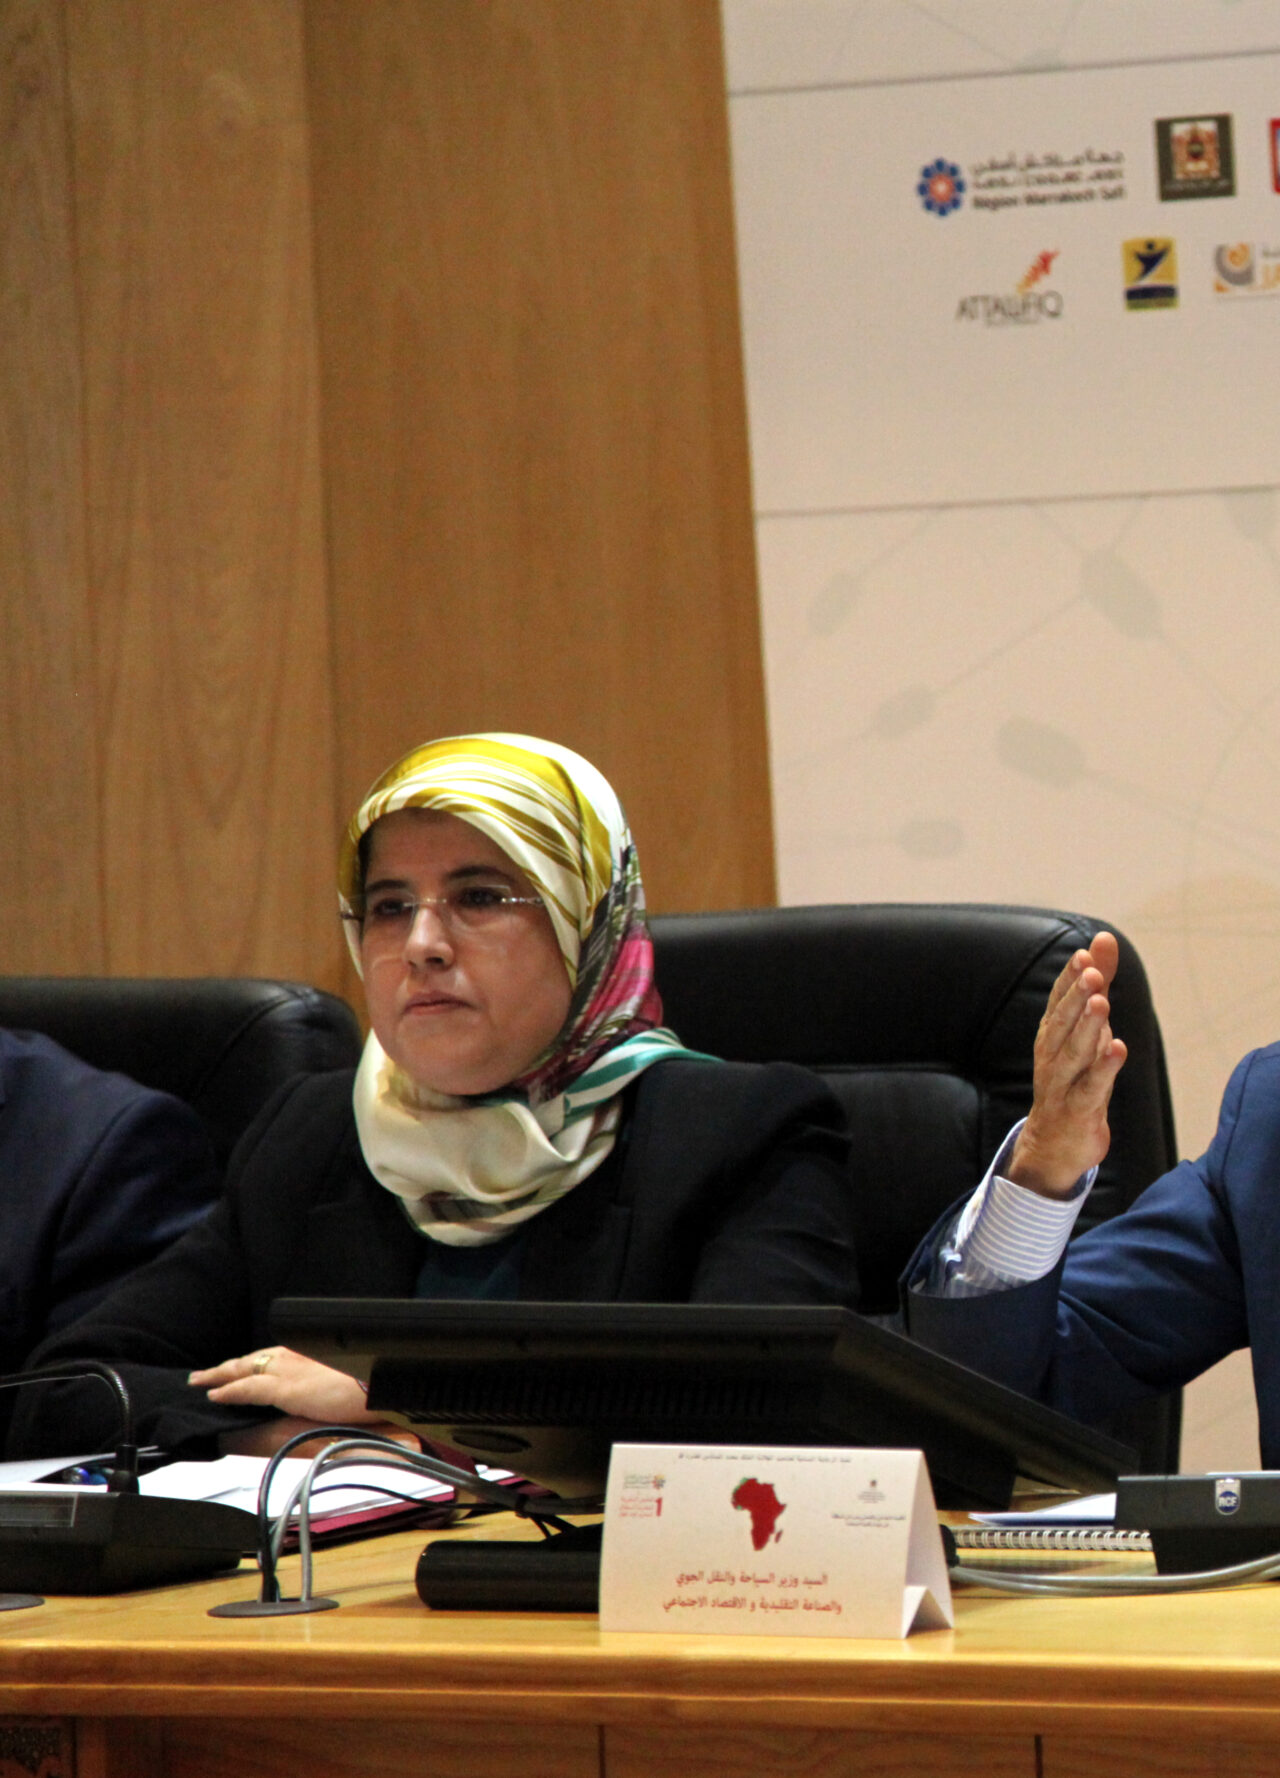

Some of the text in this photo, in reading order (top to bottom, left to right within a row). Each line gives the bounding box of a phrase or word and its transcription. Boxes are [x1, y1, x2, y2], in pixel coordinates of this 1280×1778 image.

[1218, 1496, 1238, 1507] RCF
[675, 1570, 828, 1589] السيد وزير السياحة والنقل الجوي
[662, 1596, 843, 1614] والصناعة التقليدية و الاقتصاد الاجتماعي
